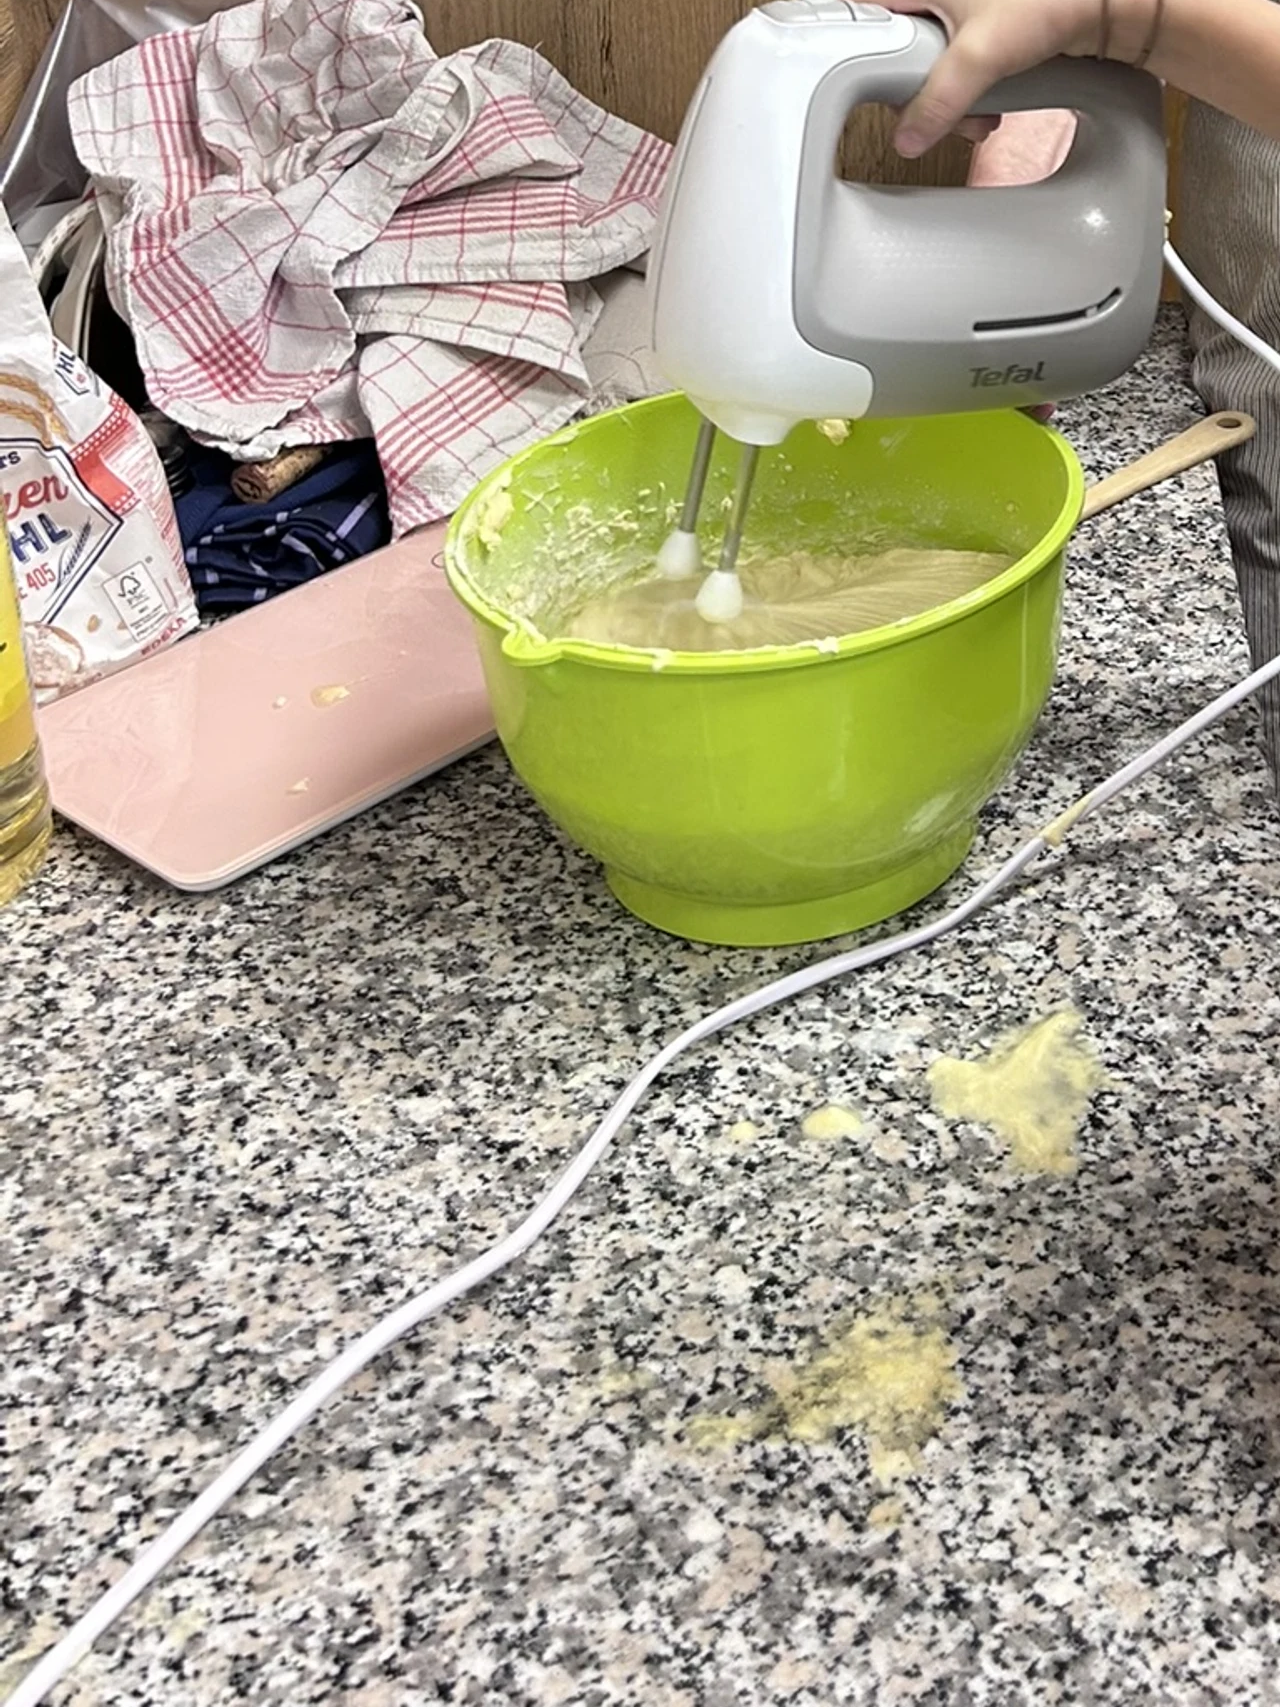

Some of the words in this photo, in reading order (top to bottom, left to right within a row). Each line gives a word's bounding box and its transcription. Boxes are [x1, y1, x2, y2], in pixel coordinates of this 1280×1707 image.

[969, 360, 1047, 387] Tefal
[11, 512, 73, 564] HL
[26, 561, 56, 591] 405
